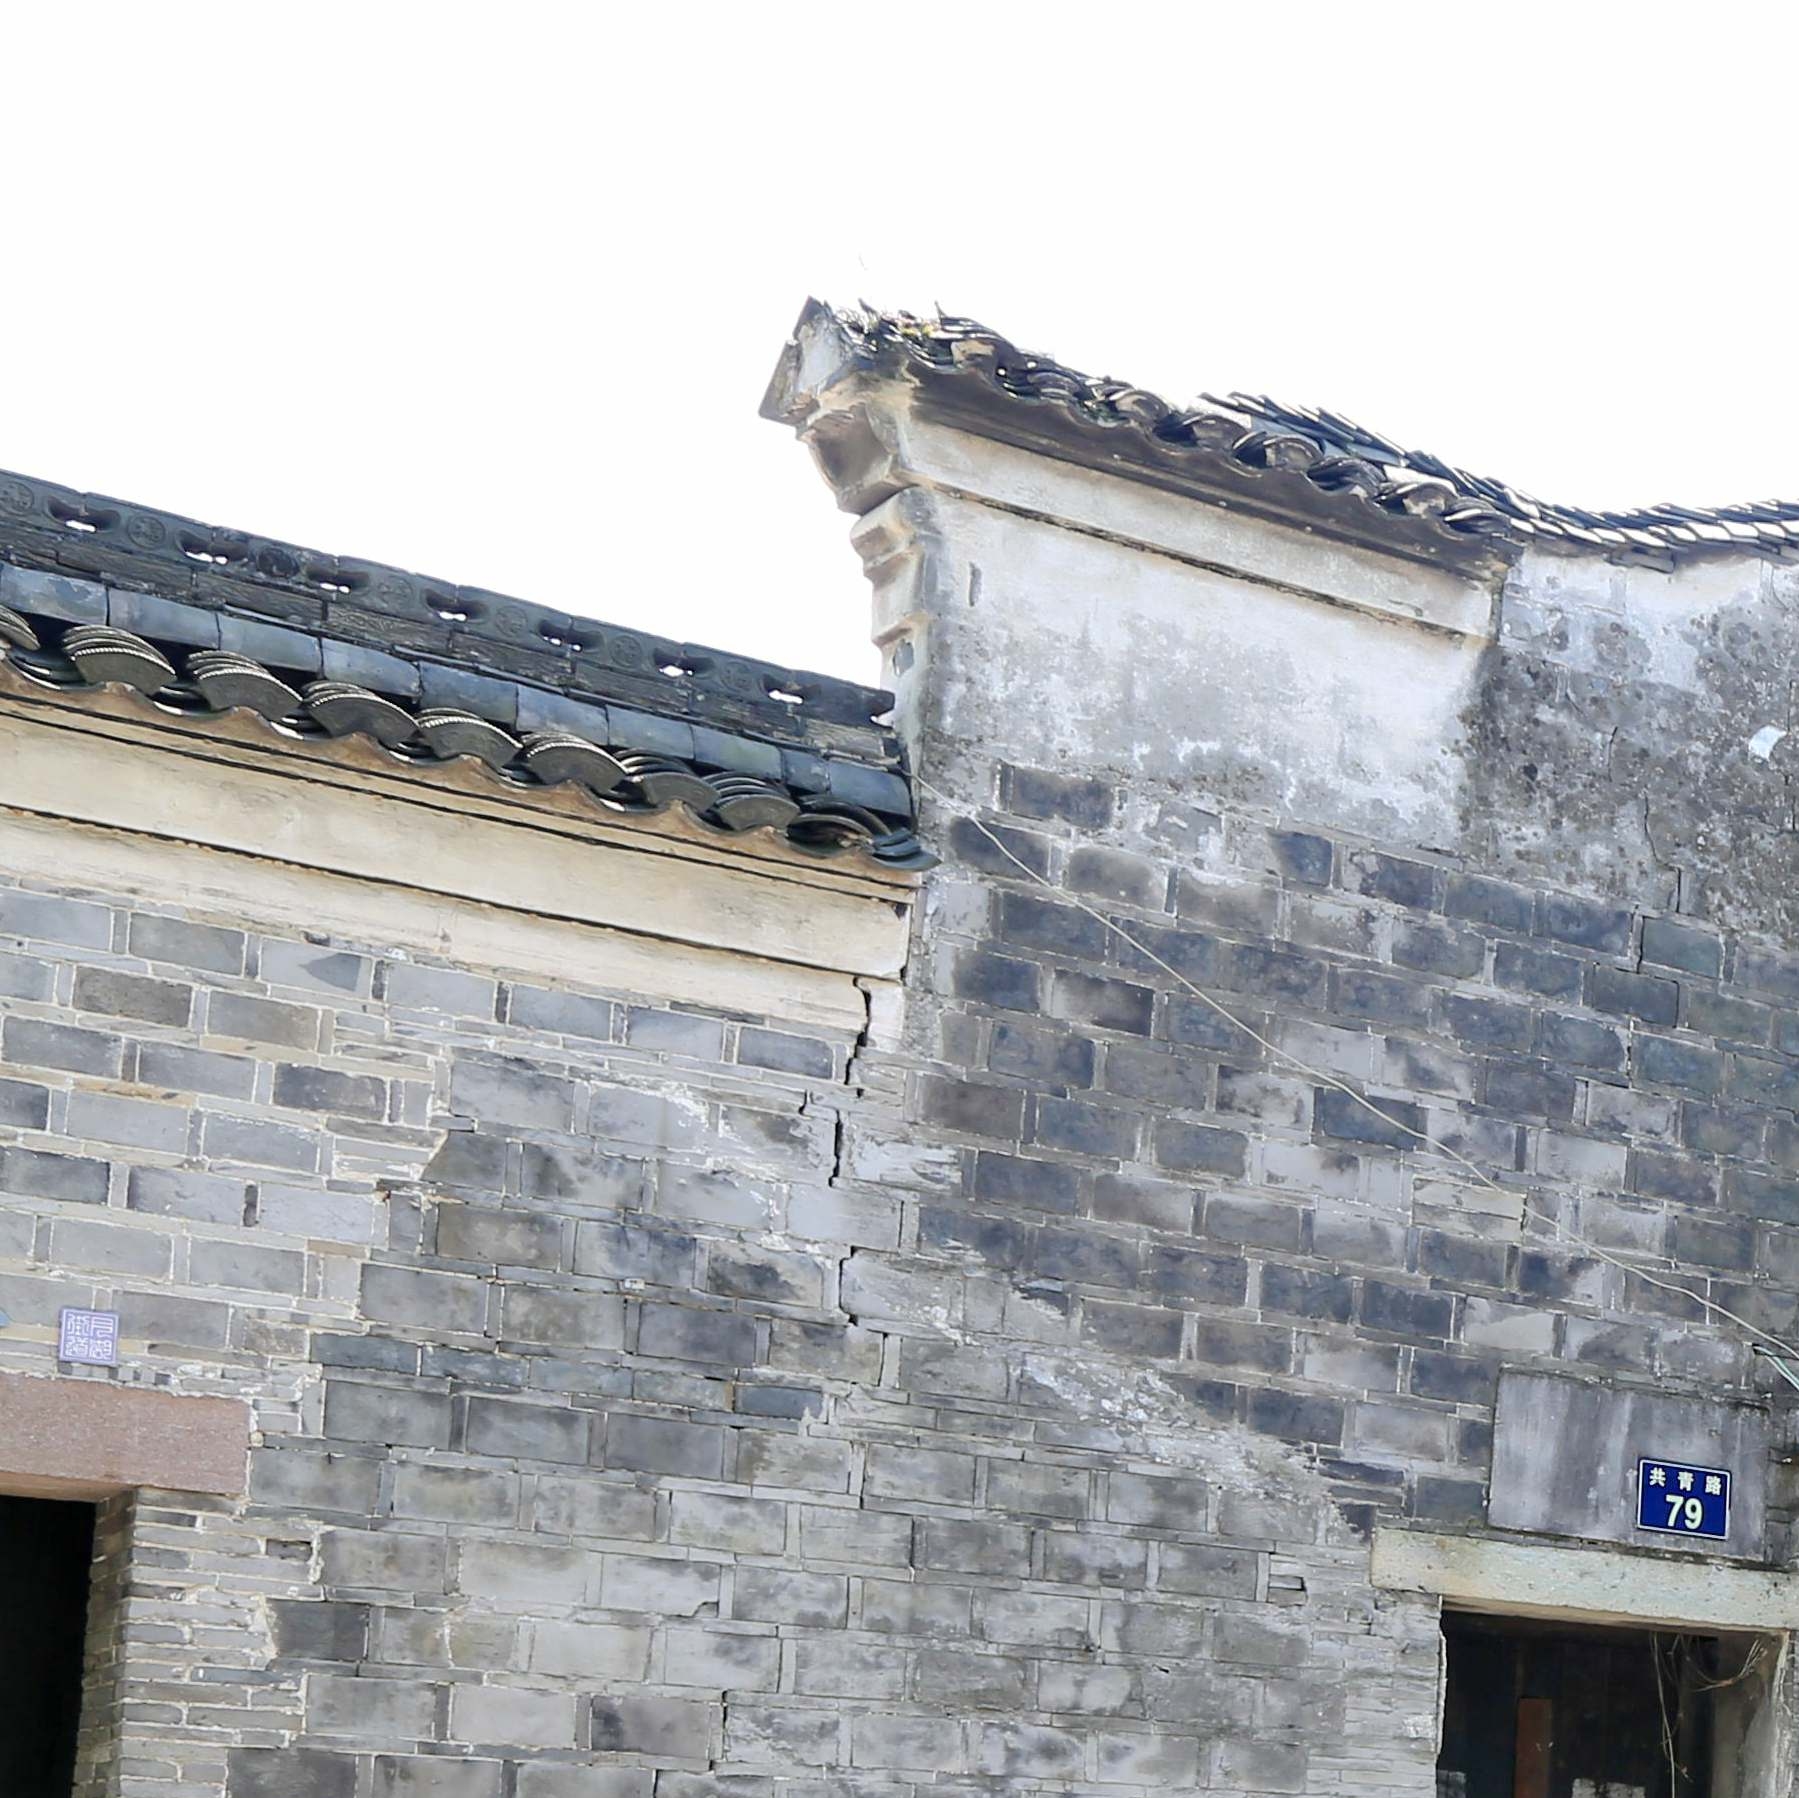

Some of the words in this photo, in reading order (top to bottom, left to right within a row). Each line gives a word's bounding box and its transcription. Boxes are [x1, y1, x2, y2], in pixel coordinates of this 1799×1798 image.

[1649, 1467, 1722, 1496] 共青路
[1666, 1494, 1702, 1529] 79
